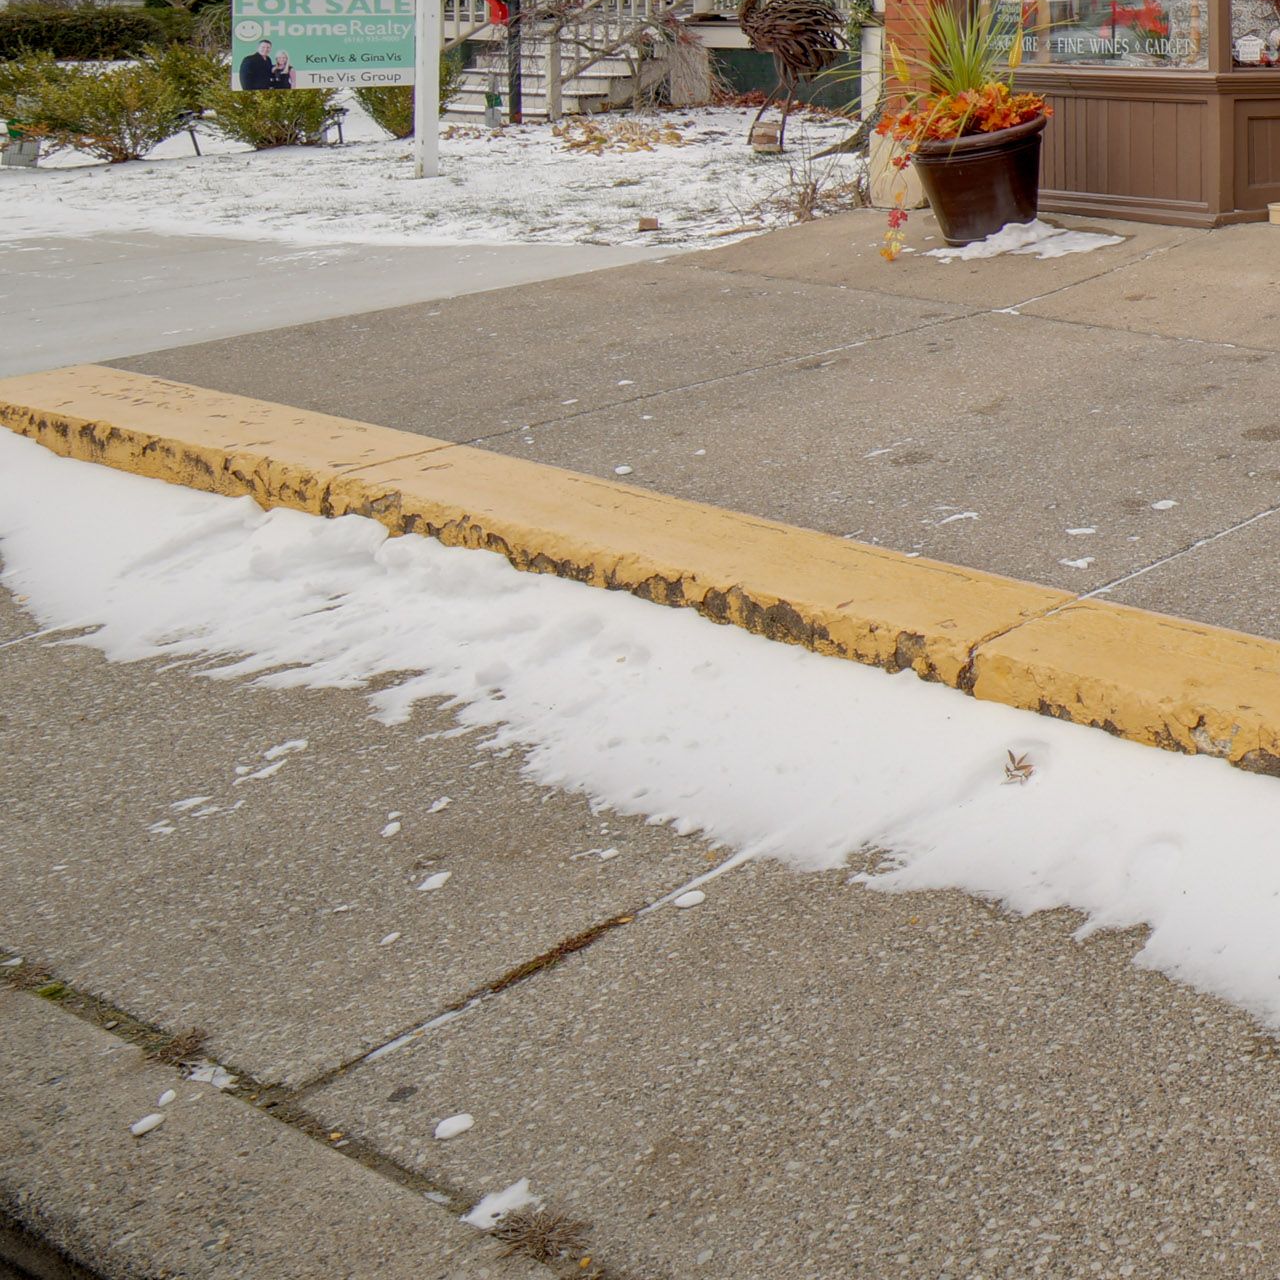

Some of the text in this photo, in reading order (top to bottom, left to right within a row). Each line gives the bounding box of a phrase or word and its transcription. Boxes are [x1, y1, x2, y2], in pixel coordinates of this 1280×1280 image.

[1057, 37, 1085, 54] FINE
[1090, 37, 1129, 54] WINES
[1145, 37, 1197, 55] GADGETS
[305, 52, 402, 64] Ken Vis & Gina Vis
[309, 71, 402, 84] The Vis Group
